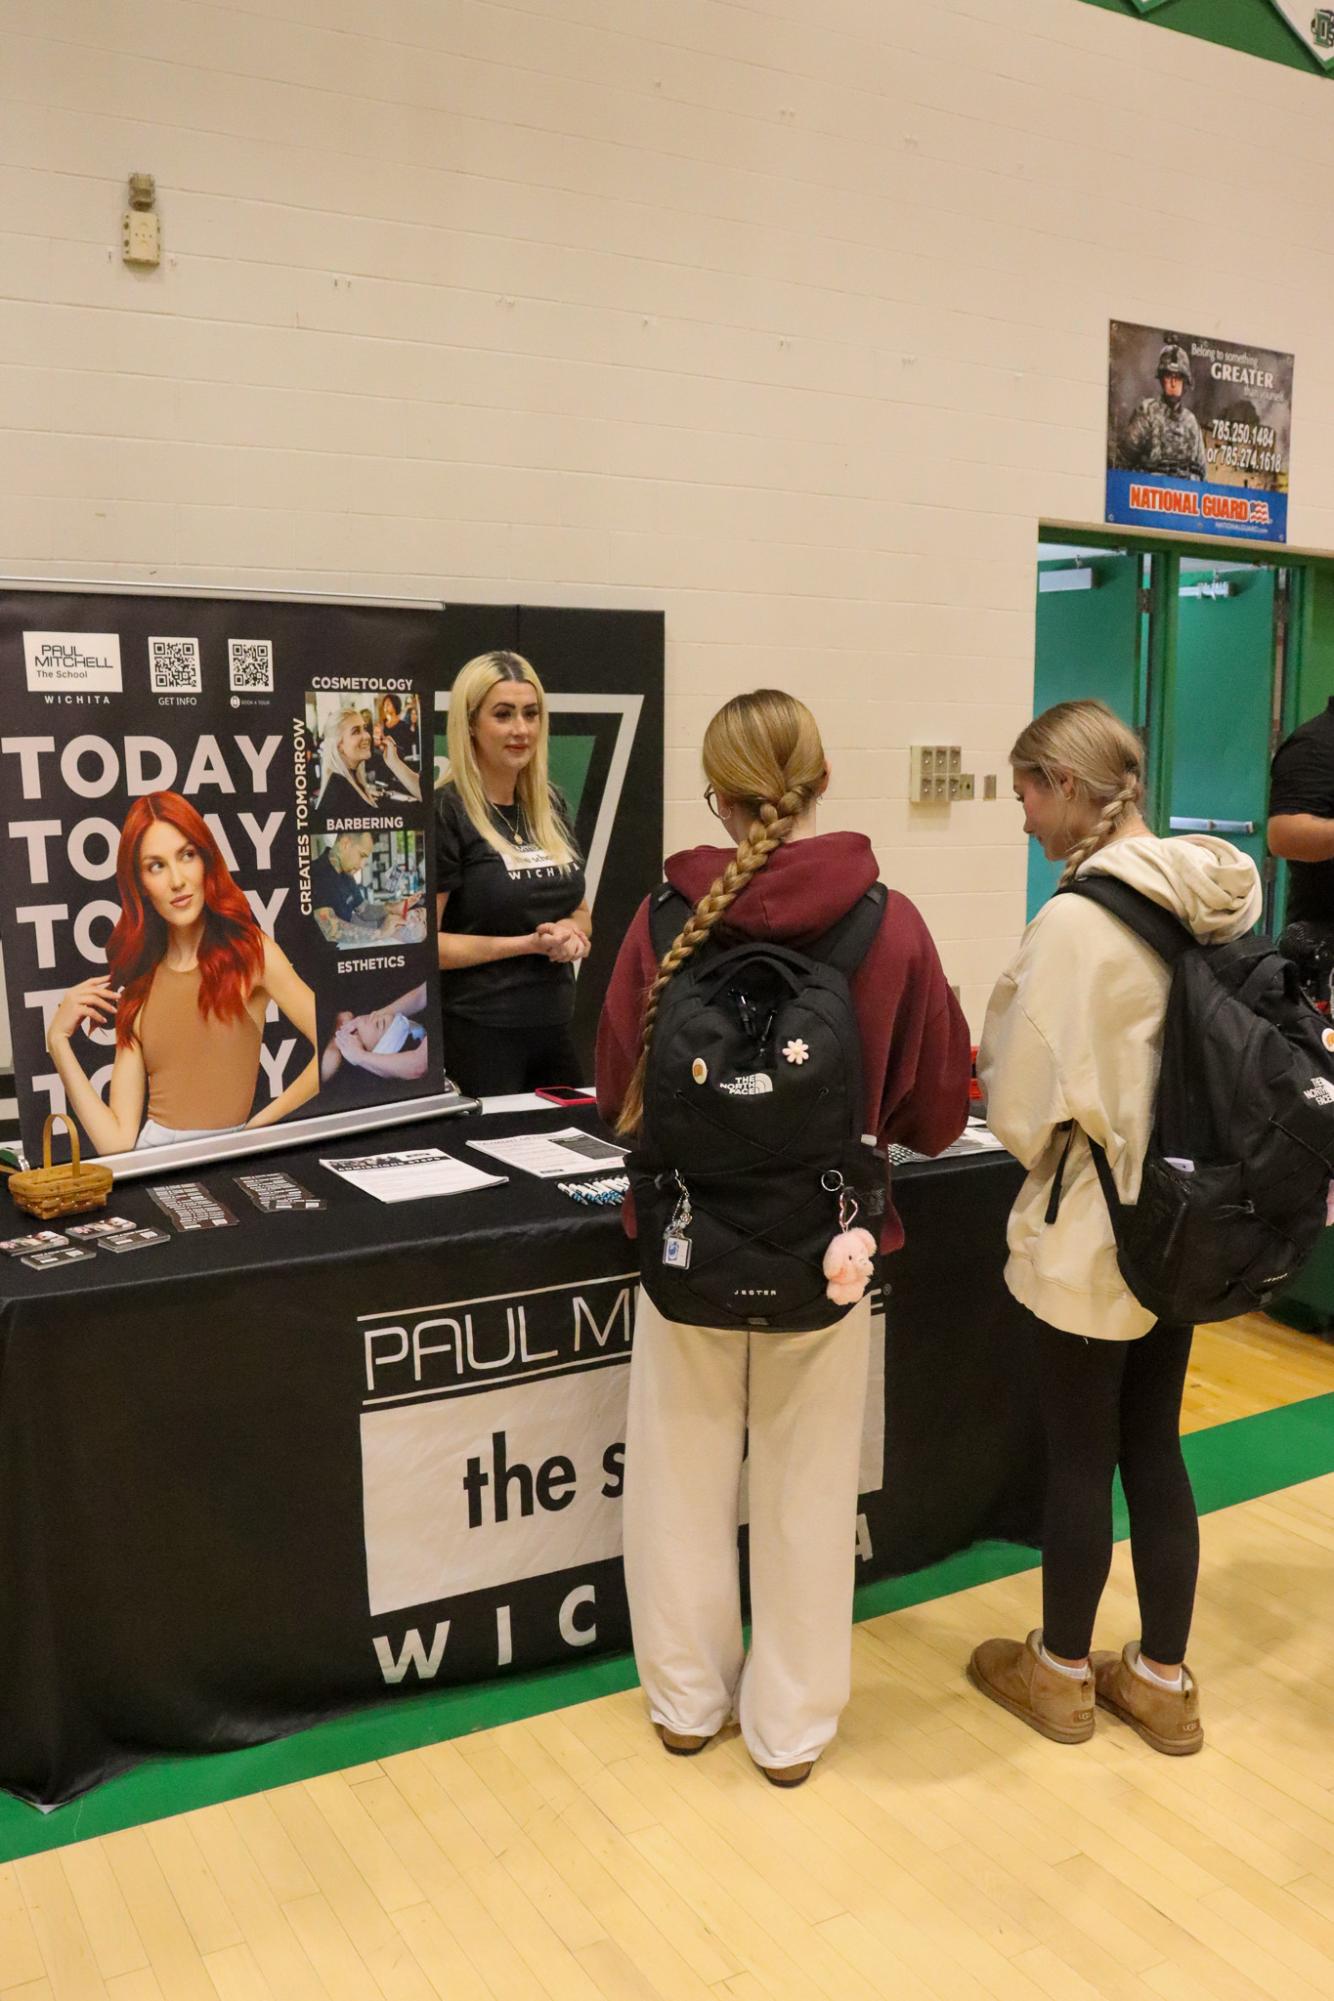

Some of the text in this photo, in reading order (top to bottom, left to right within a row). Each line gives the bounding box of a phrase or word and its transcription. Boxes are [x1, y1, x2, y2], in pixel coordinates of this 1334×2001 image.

[1191, 343, 1215, 362] Belong
[1216, 350, 1224, 359] to
[1211, 362, 1274, 388] GREATER
[1212, 419, 1274, 448] 785.250.1484
[1207, 445, 1282, 473] or 785.274.1618
[1129, 484, 1250, 522] NATIONAL GUARD
[41, 644, 83, 657] PAUL
[34, 656, 114, 669] MITCHELL
[37, 670, 88, 679] The School
[311, 676, 413, 691] COSMETOLOGY
[44, 695, 111, 705] WICHITA
[158, 697, 197, 706] GET INFO
[1, 734, 284, 800] TODAY
[293, 717, 312, 916] CREATES TOMORROW
[326, 816, 404, 832] BARBERING
[8, 811, 286, 885] TOAY
[16, 887, 290, 969] TOY
[337, 955, 406, 974] ESTHETICS
[720, 1082, 756, 1091] NORTH
[735, 1075, 756, 1084] THE
[364, 1306, 559, 1391] PAUL
[463, 1430, 577, 1529] the
